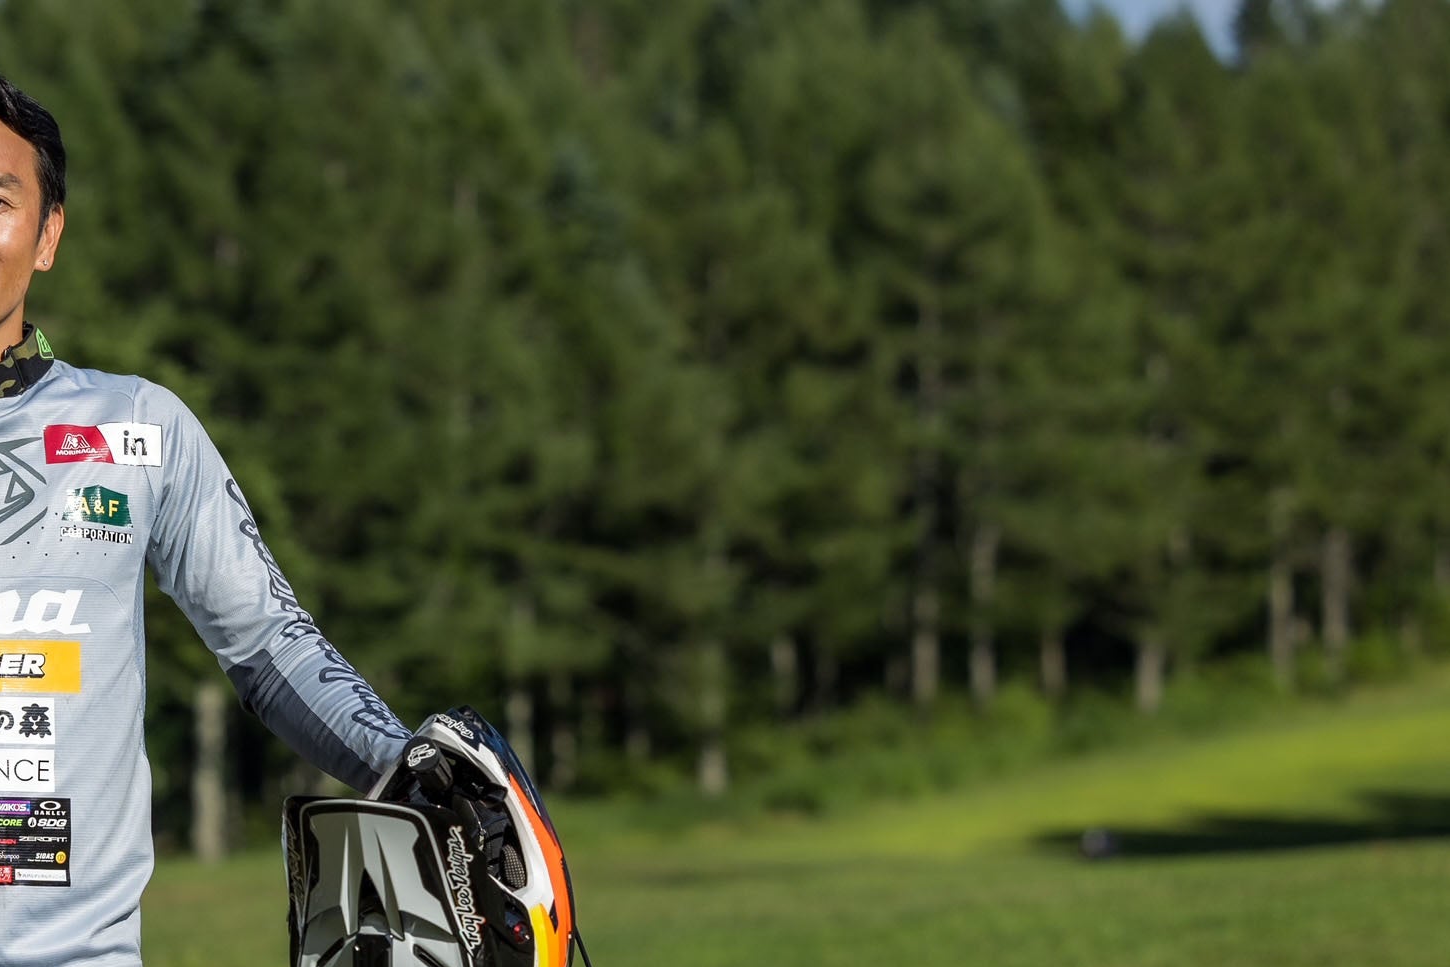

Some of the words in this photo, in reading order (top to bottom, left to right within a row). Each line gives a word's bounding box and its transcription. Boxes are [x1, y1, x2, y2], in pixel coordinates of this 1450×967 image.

[55, 448, 97, 456] MORINAGA
[123, 430, 148, 456] in
[93, 499, 104, 514] &
[109, 499, 119, 517] F
[37, 818, 67, 827] SDG
[446, 825, 474, 889] Designs
[453, 886, 476, 915] Lee
[459, 914, 487, 957] Troy
